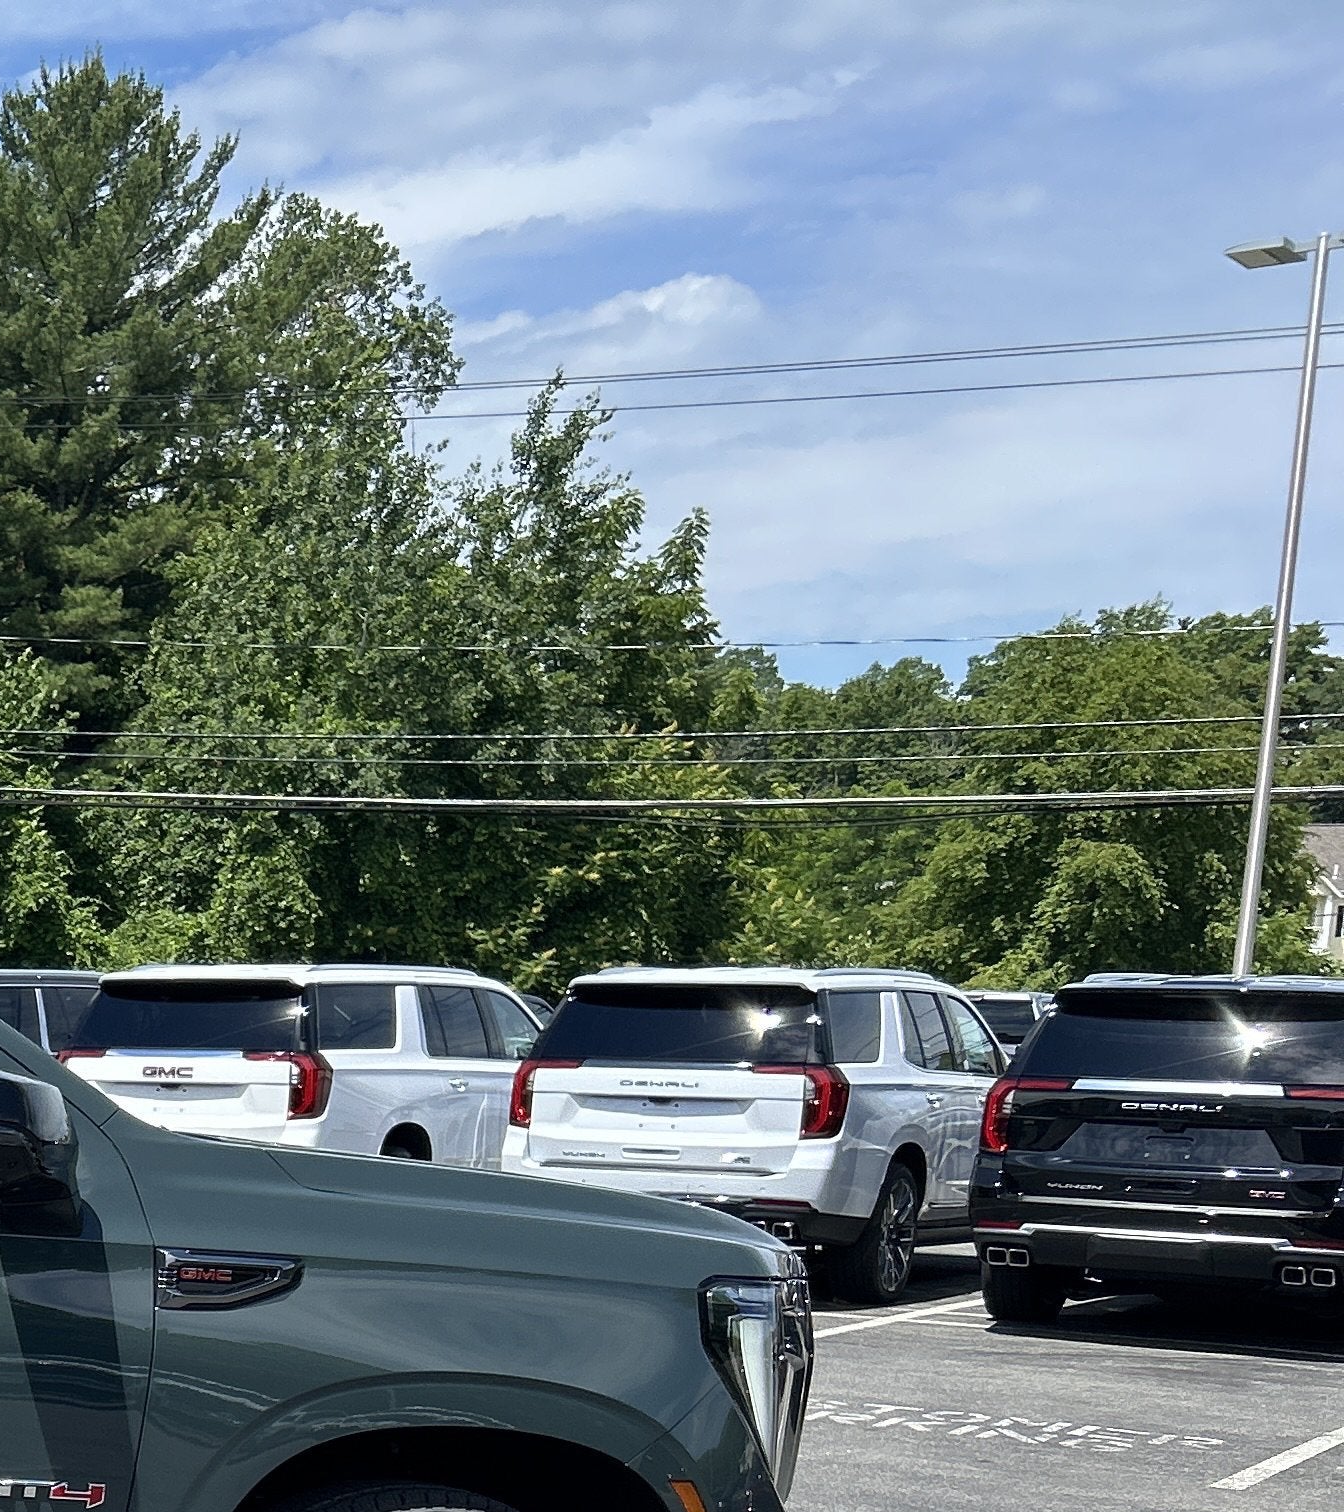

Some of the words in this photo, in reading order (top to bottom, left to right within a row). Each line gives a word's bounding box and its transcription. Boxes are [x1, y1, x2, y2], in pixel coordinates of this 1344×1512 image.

[142, 1066, 194, 1079] GMC
[619, 1079, 699, 1089] DENALI
[1121, 1102, 1224, 1113] DENALI
[1047, 1181, 1104, 1191] YUKON
[179, 1267, 233, 1282] GMC
[804, 1411, 1134, 1453] RKING
